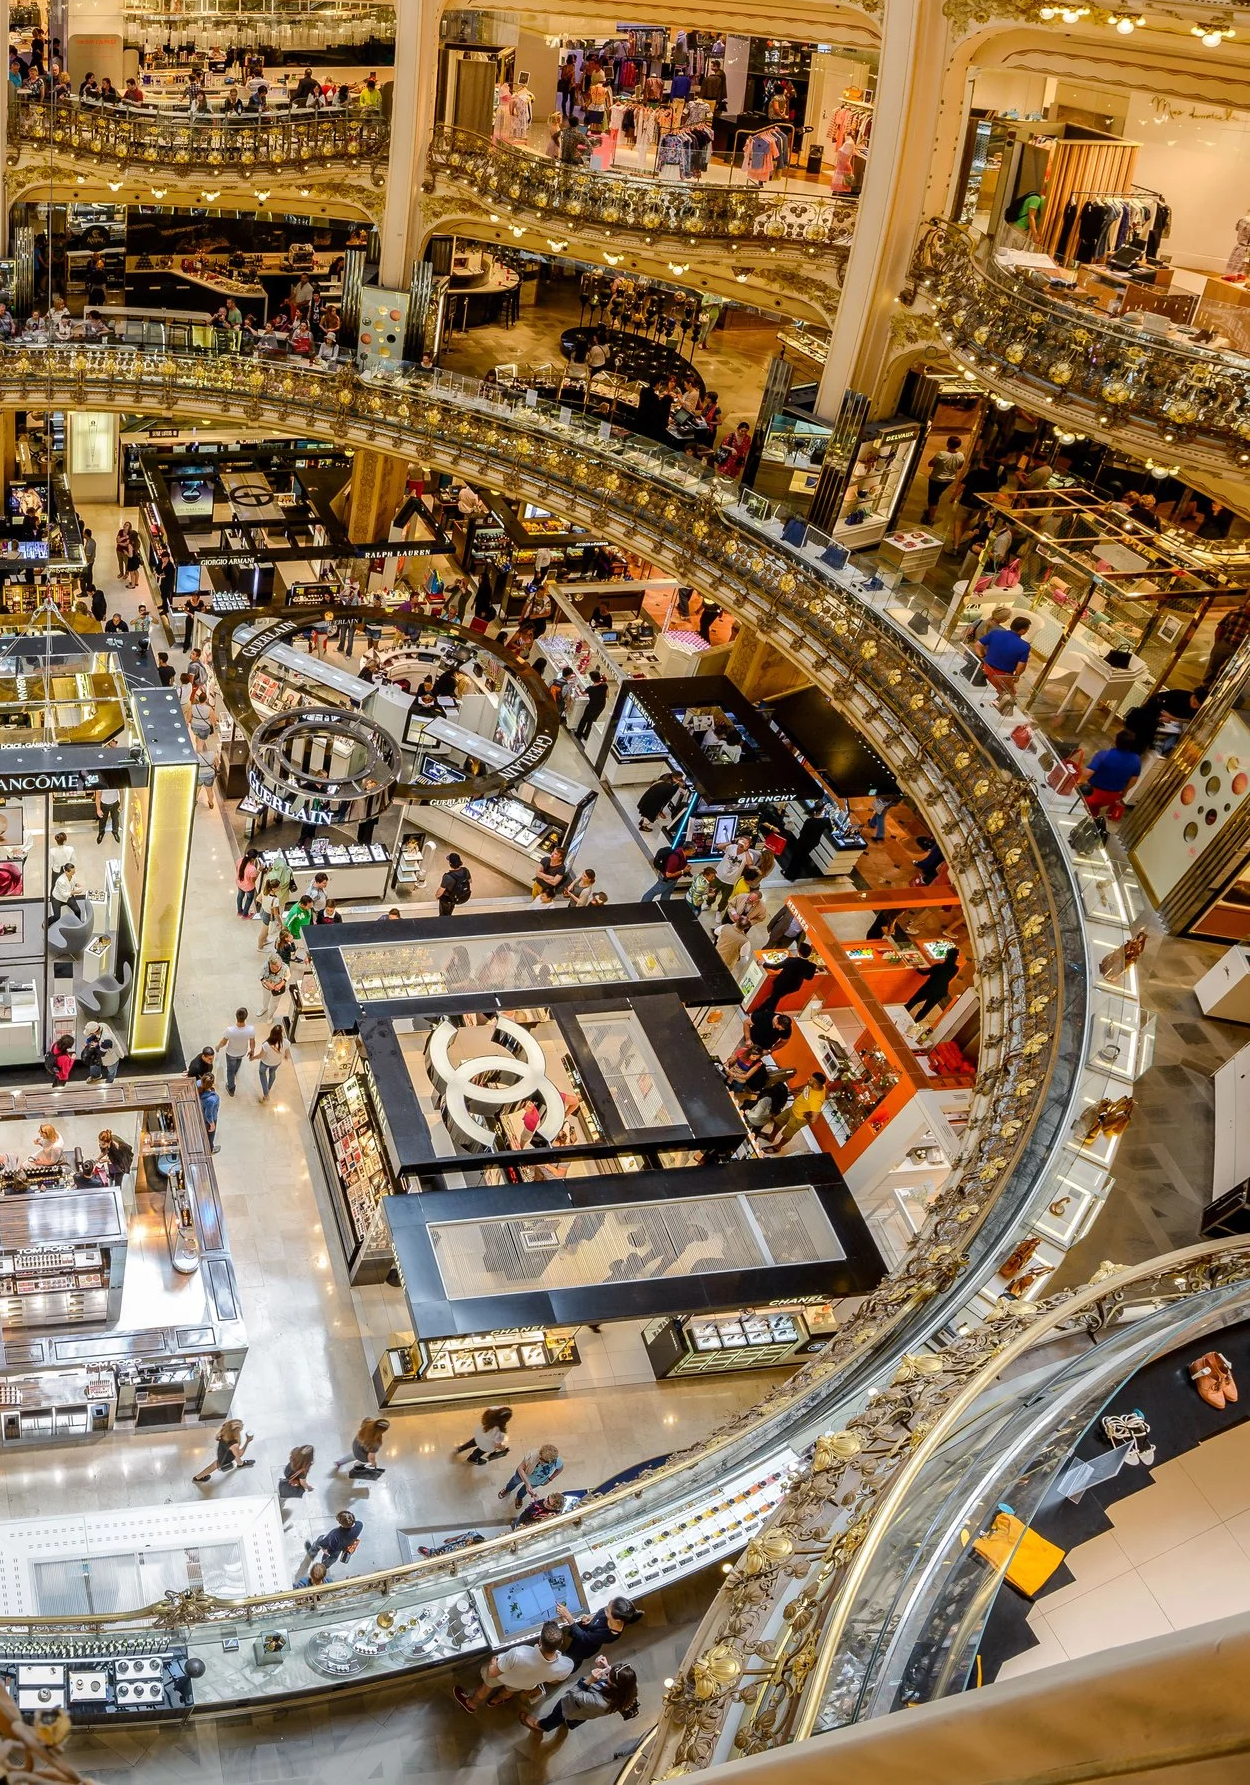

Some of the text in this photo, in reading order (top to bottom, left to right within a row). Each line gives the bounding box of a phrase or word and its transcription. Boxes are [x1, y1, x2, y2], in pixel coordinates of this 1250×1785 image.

[885, 431, 914, 442] DELVAUX
[365, 549, 431, 559] RALPH LAUREN
[200, 557, 255, 566] GIORGIO ARMANI
[325, 618, 359, 626] GUERLAIN
[242, 620, 298, 657] GUERLAIN
[629, 692, 656, 728] GIVENCHY
[498, 734, 553, 780] GUERLAIN
[249, 771, 335, 825] GUERLAIN
[430, 797, 472, 806] GUERLAIN
[738, 794, 797, 804] GIVENCHY
[364, 1059, 388, 1134] CHANEL
[17, 1244, 75, 1255] TOM FORD
[769, 1294, 825, 1306] CHANEL
[490, 1324, 546, 1335] CHANEL
[110, 1358, 143, 1367] FORD
